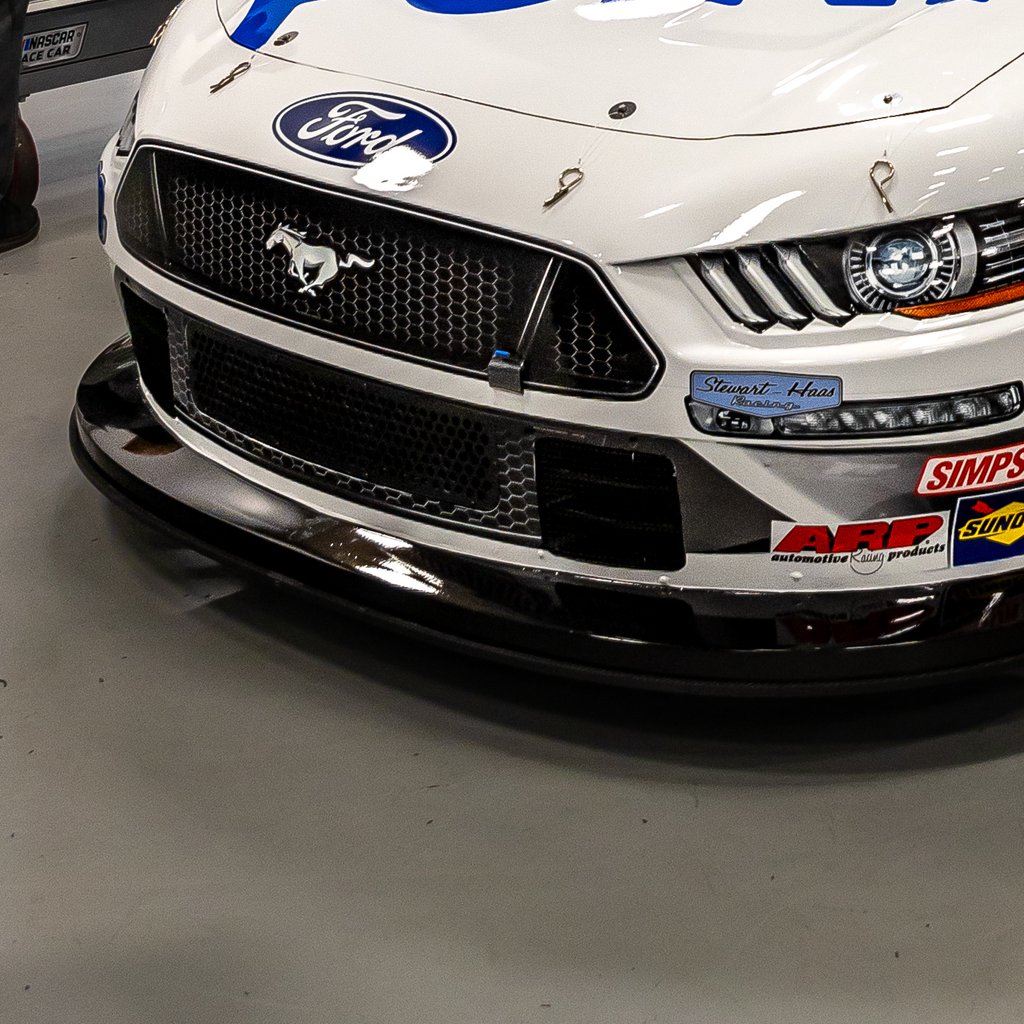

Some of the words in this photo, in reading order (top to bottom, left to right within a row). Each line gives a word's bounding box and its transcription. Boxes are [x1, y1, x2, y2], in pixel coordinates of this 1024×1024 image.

[29, 30, 75, 50] NASCAR
[22, 52, 44, 63] ACE
[46, 45, 71, 58] CAR
[298, 100, 423, 157] Ford
[696, 376, 777, 396] Stewart
[786, 381, 836, 397] Haas
[730, 395, 800, 411] Racing
[772, 515, 945, 554] ARP
[771, 552, 849, 564] automotive
[887, 542, 945, 562] products
